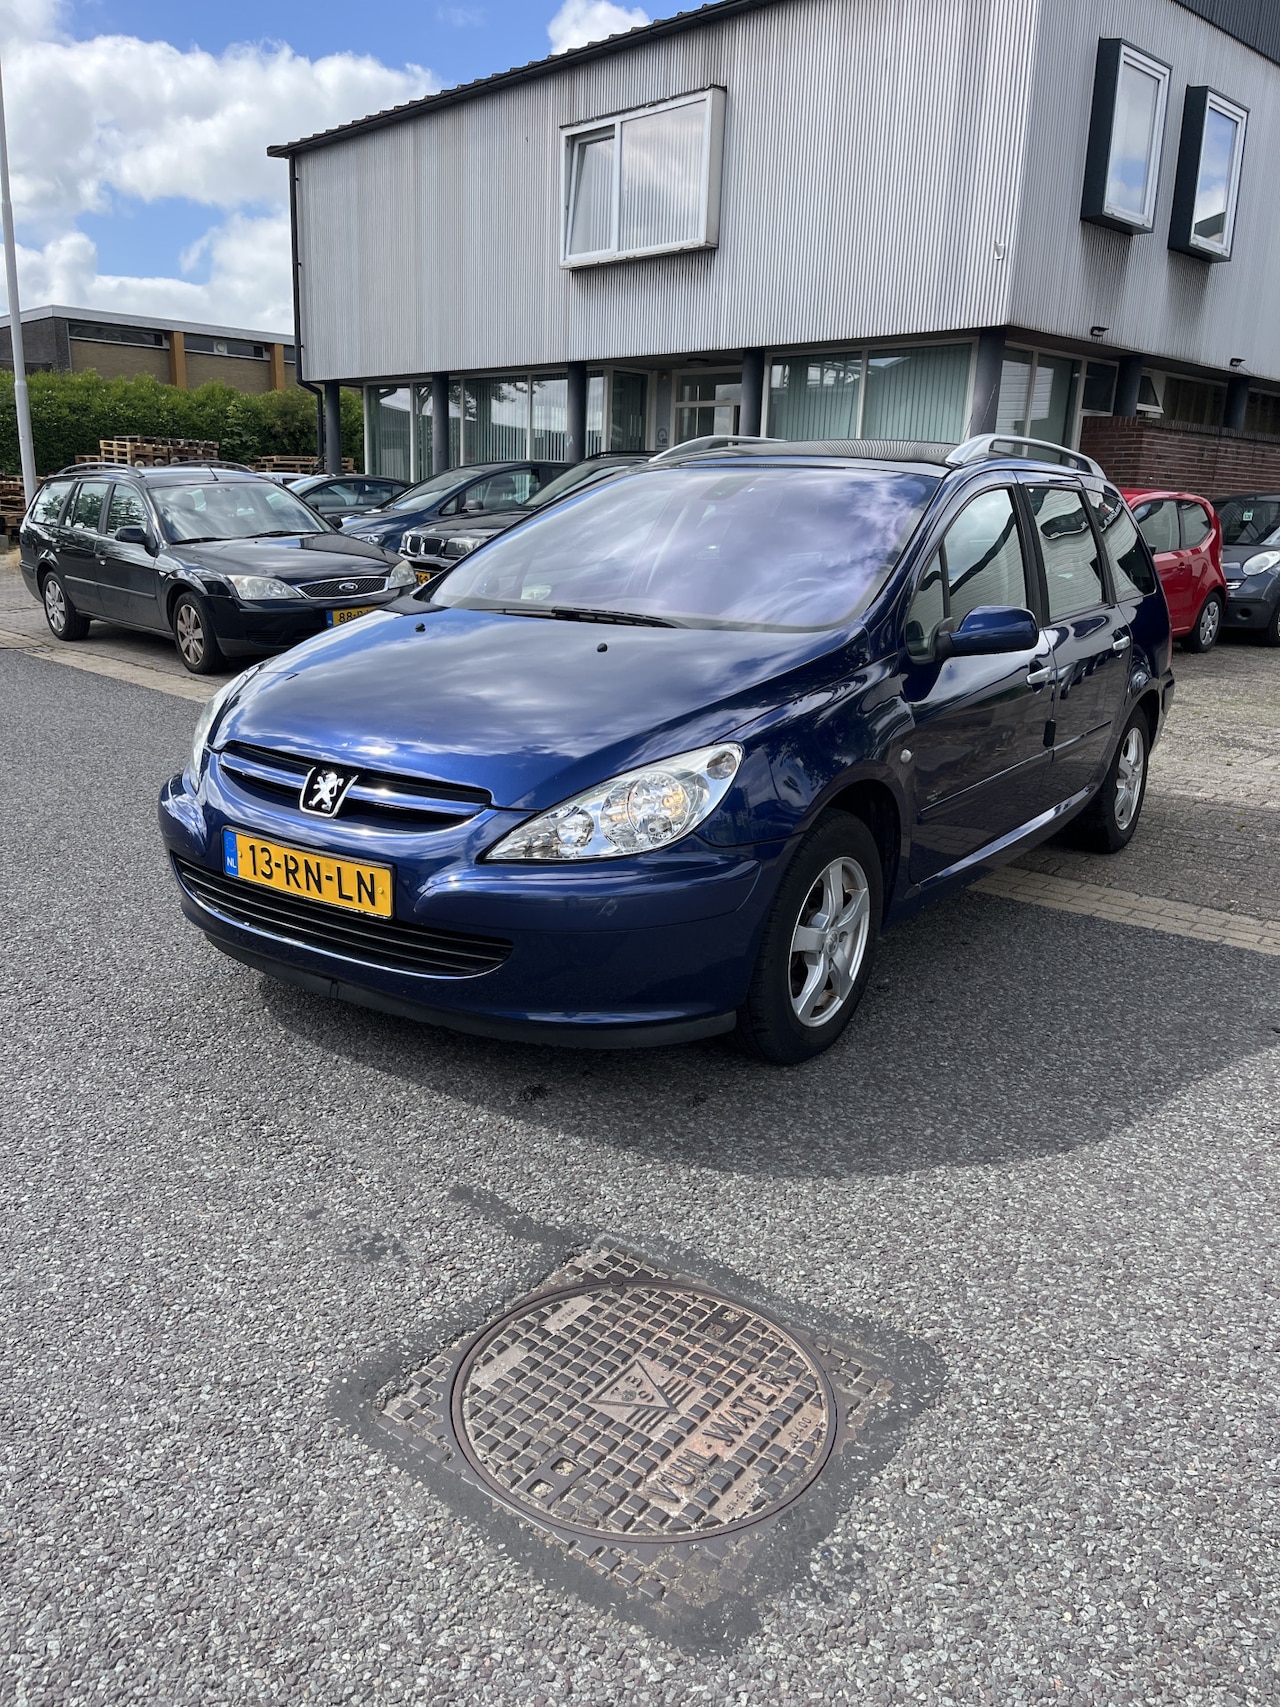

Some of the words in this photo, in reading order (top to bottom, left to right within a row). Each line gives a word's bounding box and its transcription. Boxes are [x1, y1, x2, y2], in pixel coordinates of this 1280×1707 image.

[226, 857, 237, 868] NL
[249, 844, 376, 906] 13-RN-LN
[646, 1448, 719, 1503] VUIL
[702, 1371, 790, 1443] WATER
